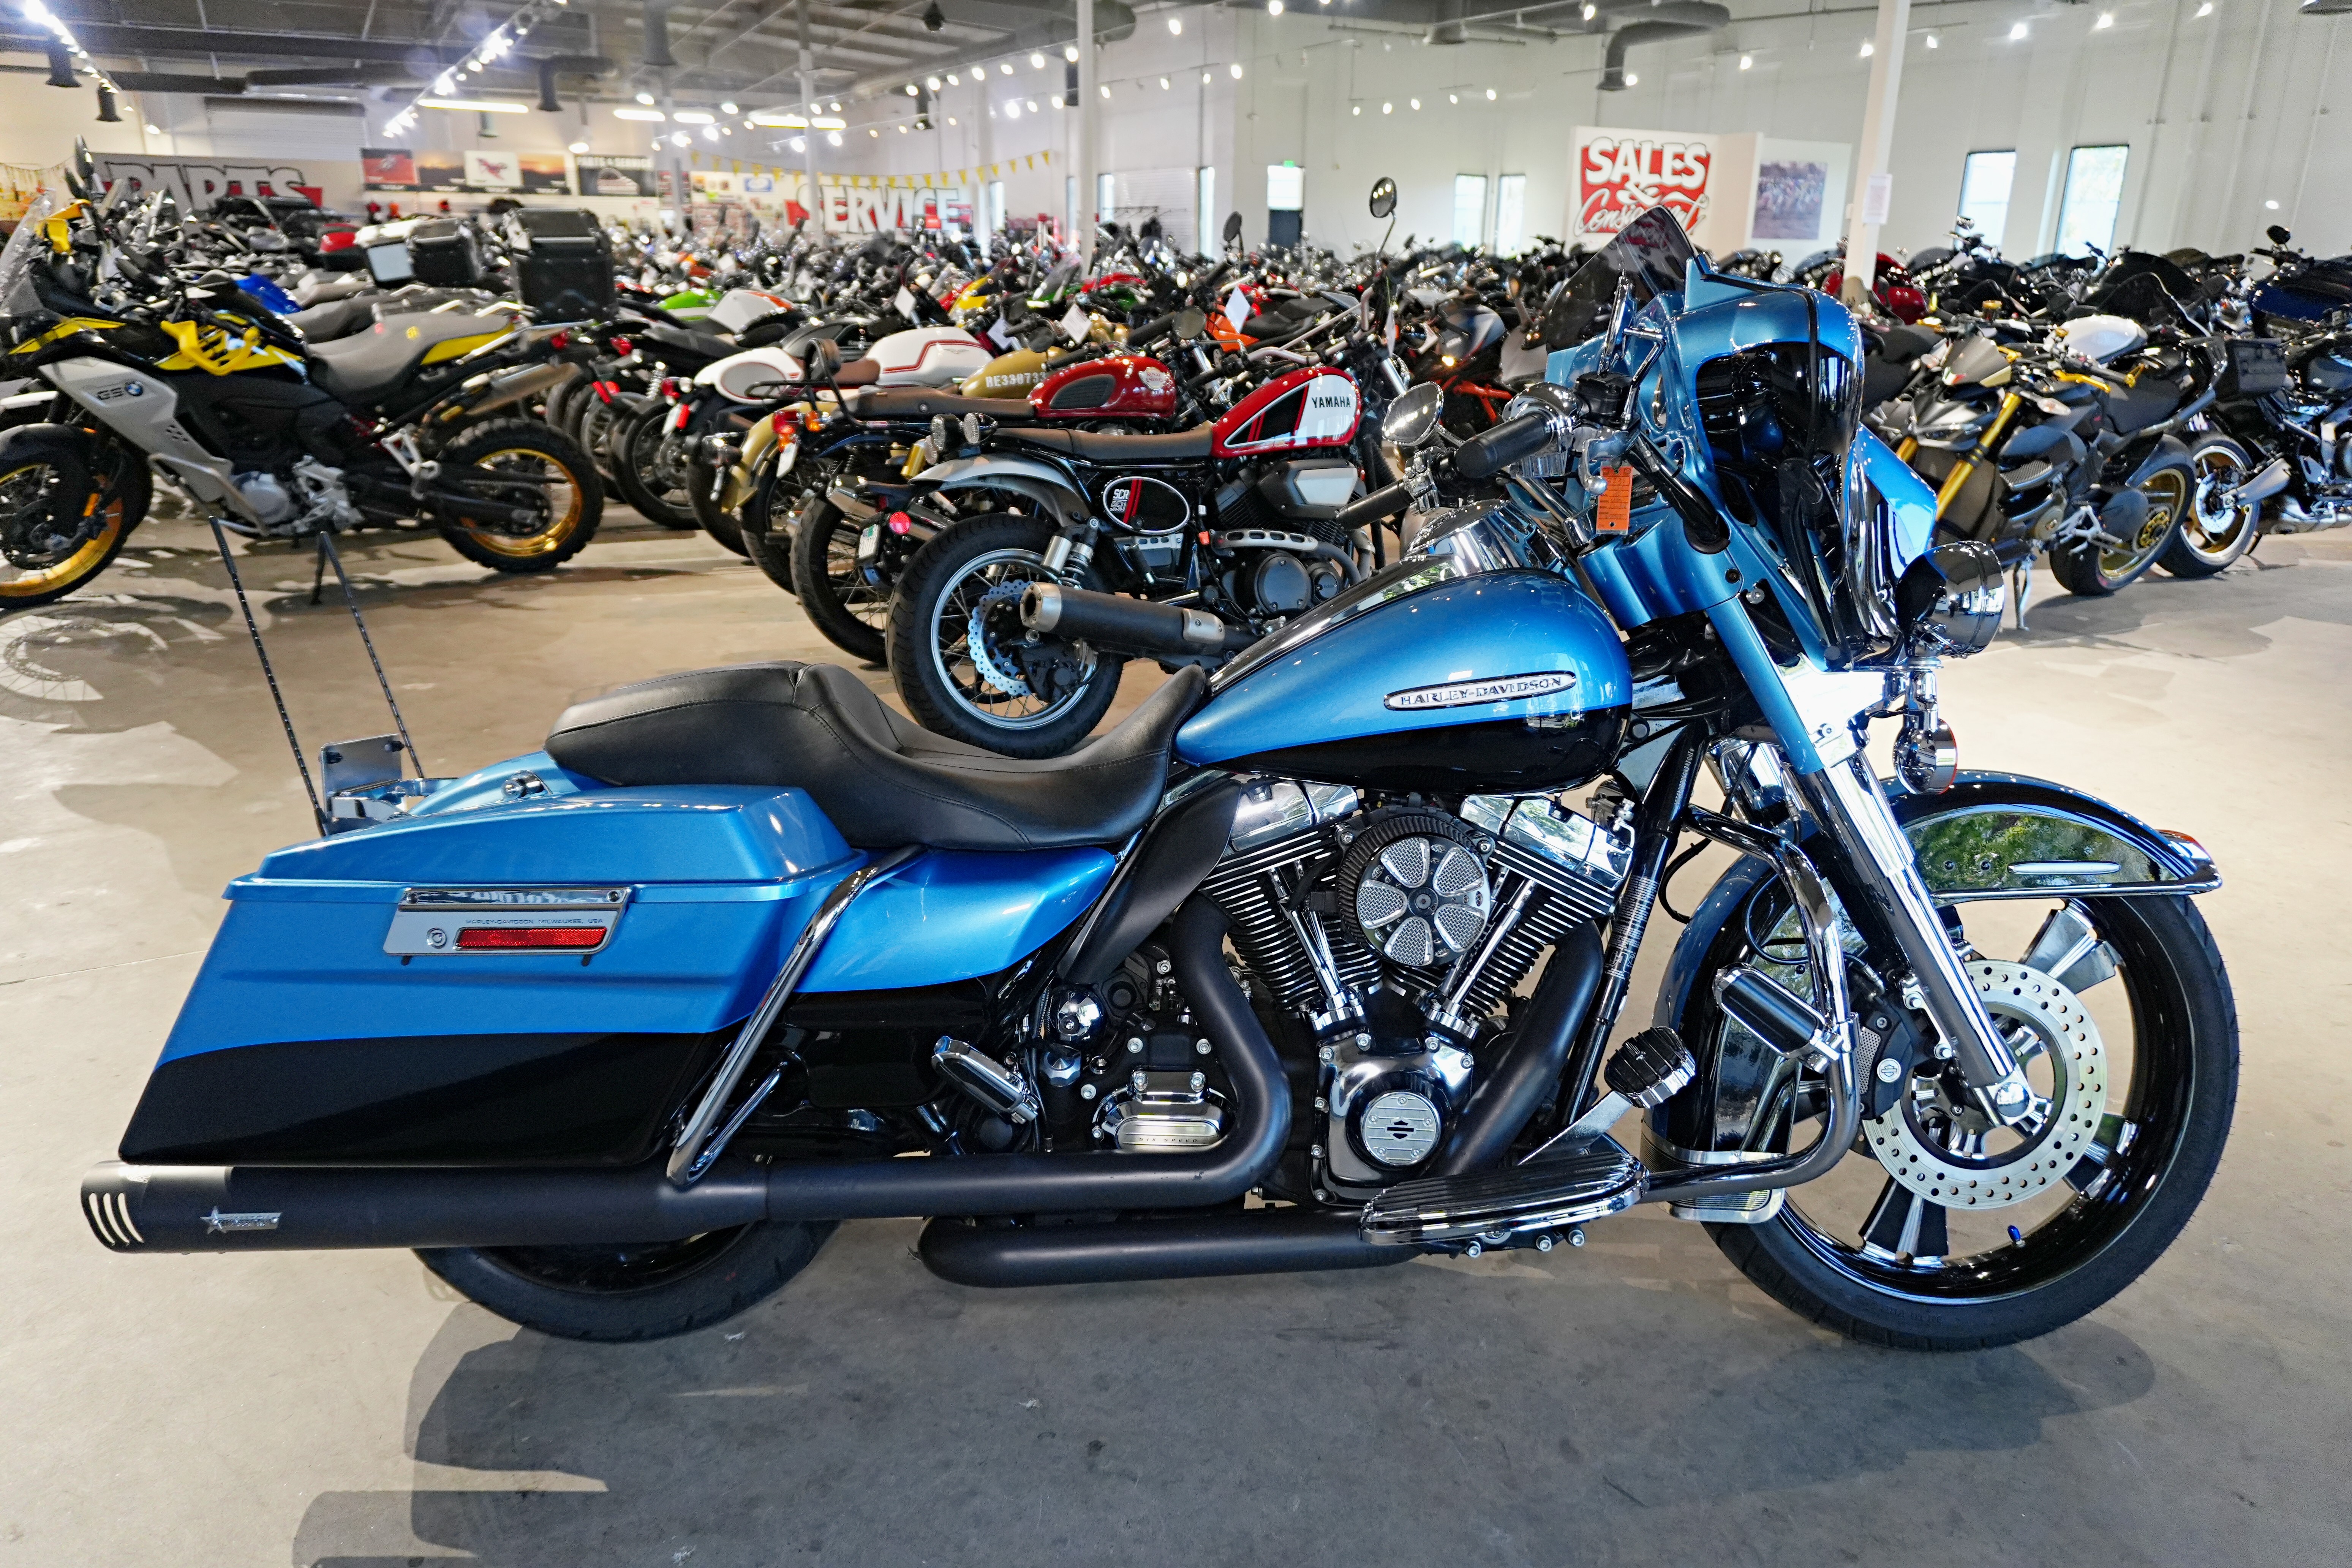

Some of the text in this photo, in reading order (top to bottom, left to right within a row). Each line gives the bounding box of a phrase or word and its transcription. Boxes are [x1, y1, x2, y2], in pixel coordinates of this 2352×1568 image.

[1585, 136, 1707, 189] SALES
[105, 161, 305, 219] PARTS
[1311, 396, 1351, 408] YAMAHA
[1113, 489, 1130, 499] SCR
[1110, 501, 1127, 512] 950
[1401, 677, 1561, 705] HARLEY-DAVIDSON
